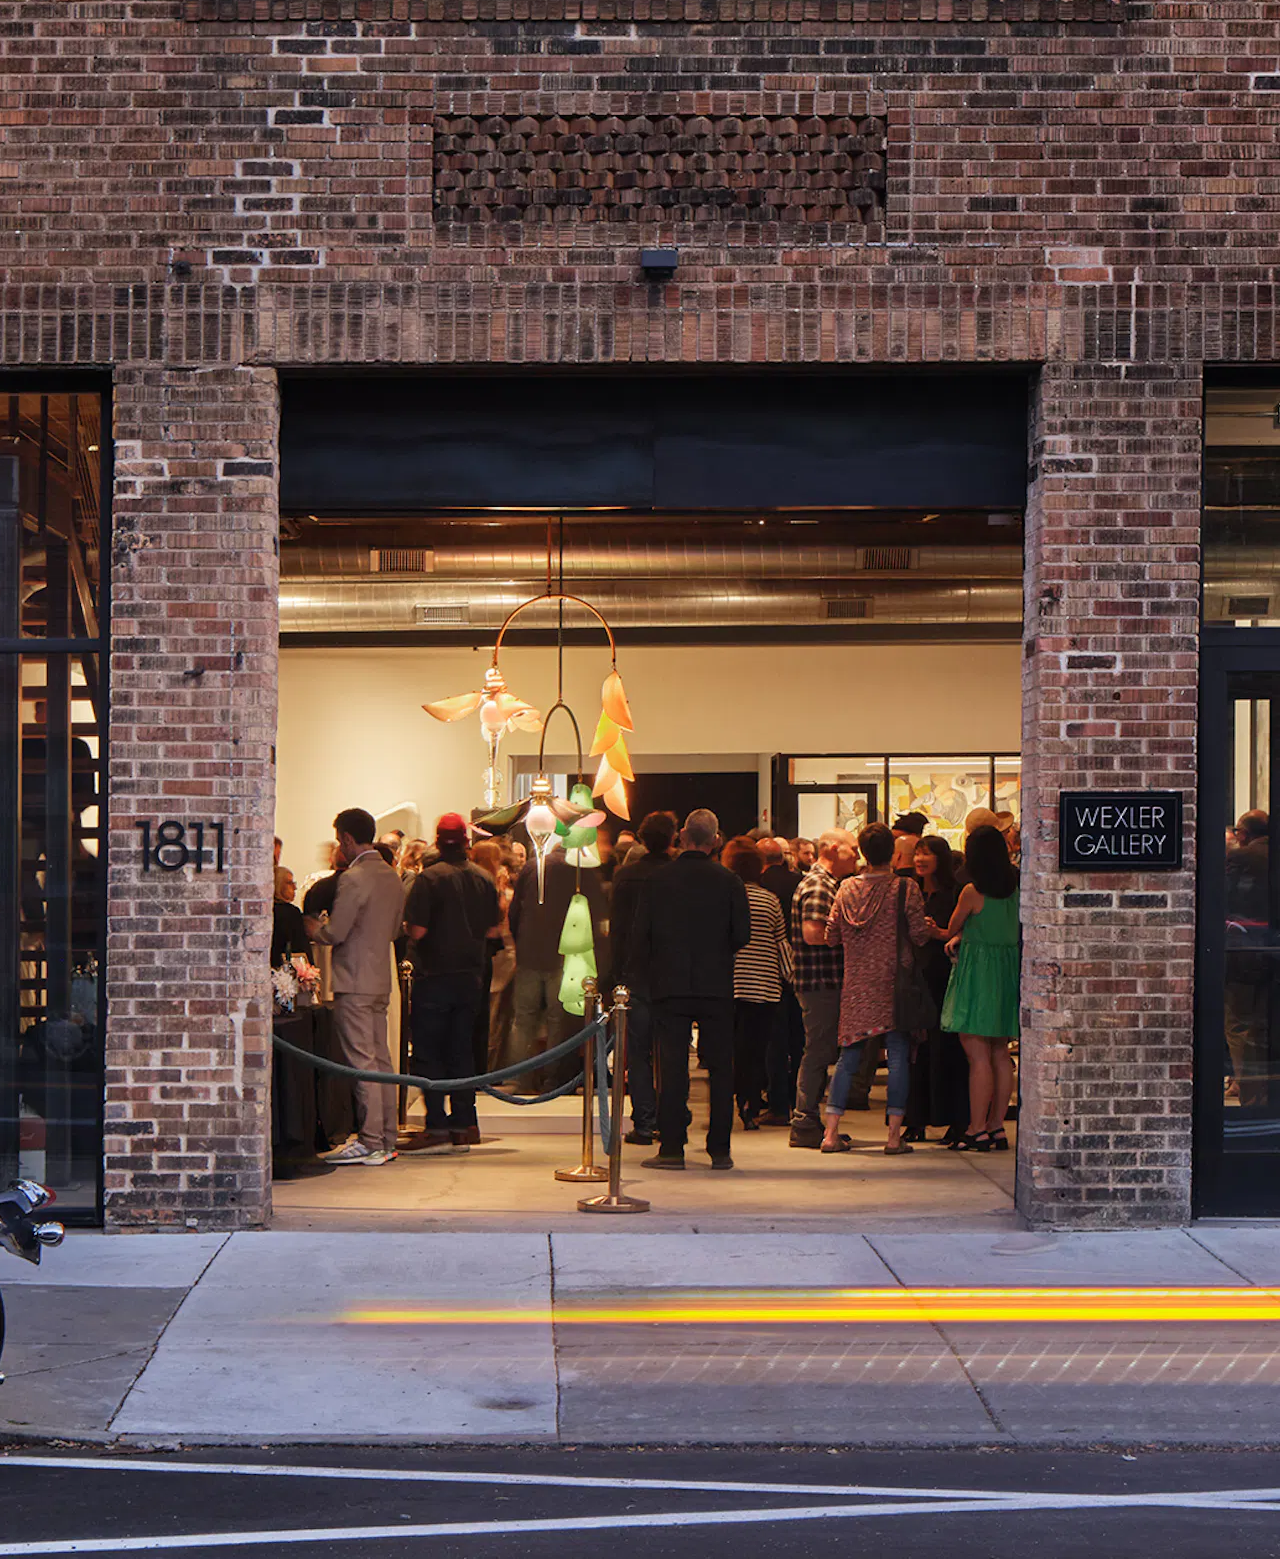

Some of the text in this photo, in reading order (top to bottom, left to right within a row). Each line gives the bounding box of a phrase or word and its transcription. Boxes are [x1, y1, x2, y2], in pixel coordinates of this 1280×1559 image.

[1074, 805, 1166, 830] WEXLER
[134, 820, 225, 873] 1811
[1073, 833, 1168, 856] GALLERY
